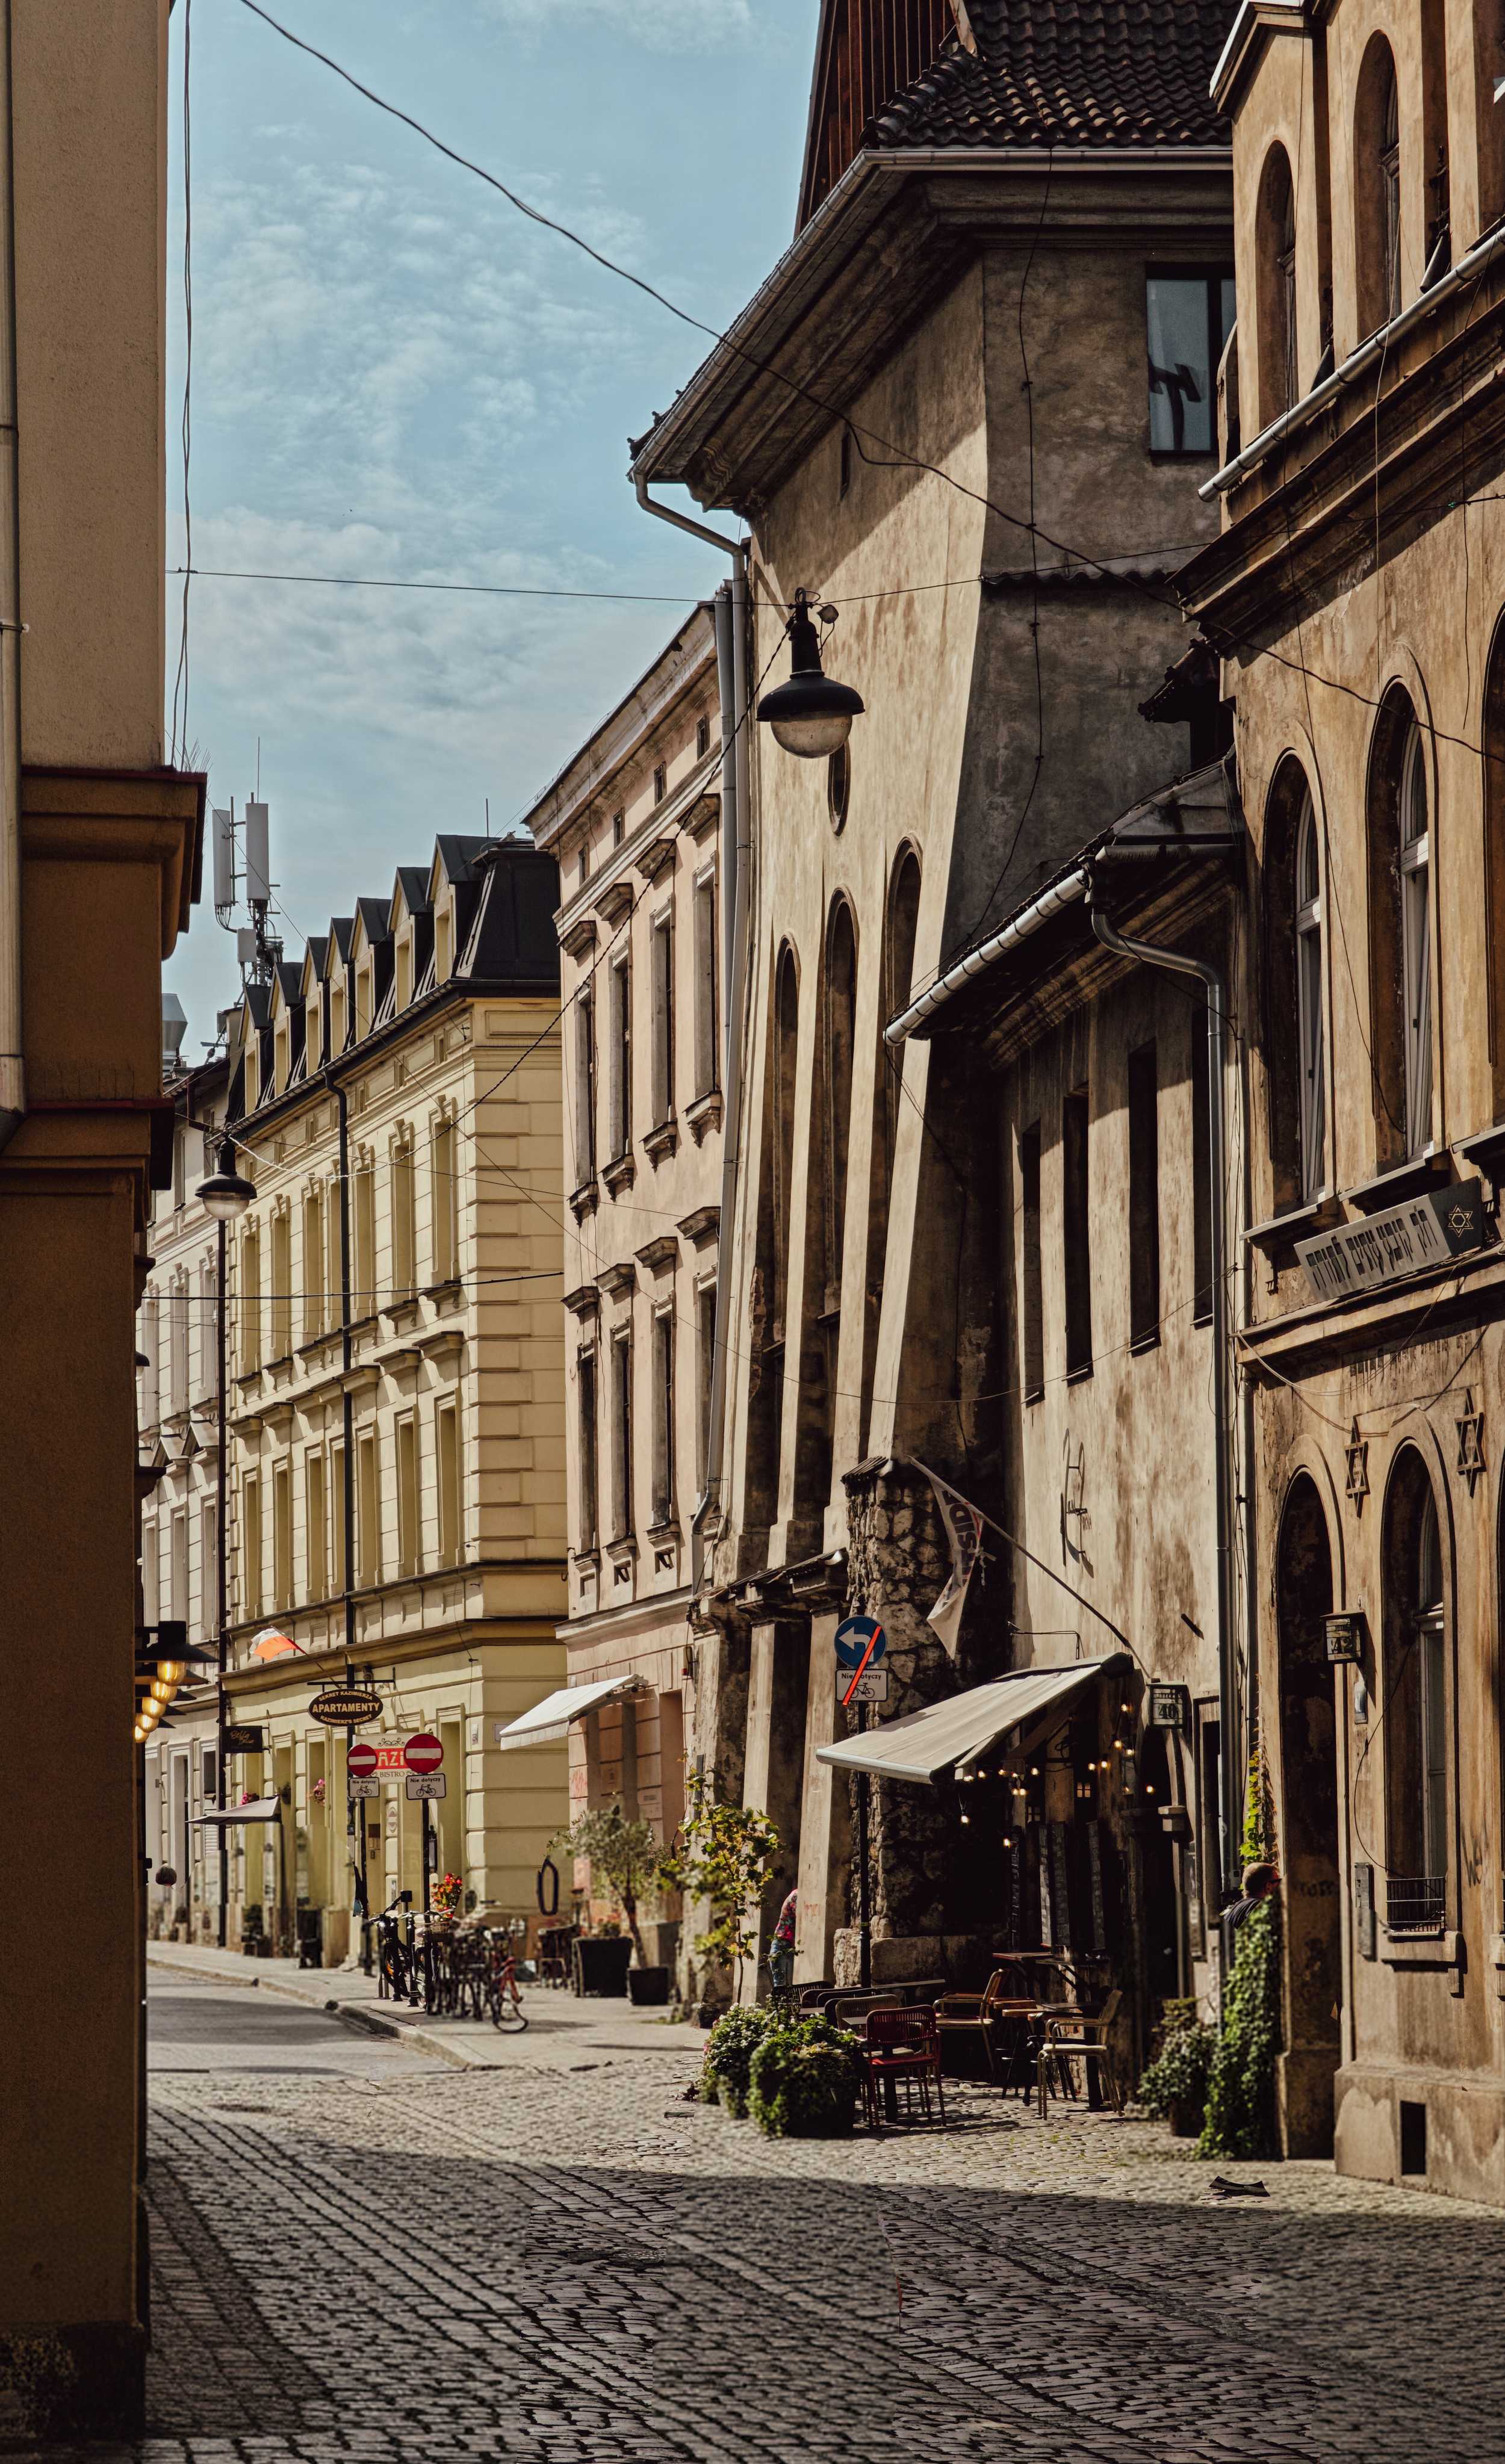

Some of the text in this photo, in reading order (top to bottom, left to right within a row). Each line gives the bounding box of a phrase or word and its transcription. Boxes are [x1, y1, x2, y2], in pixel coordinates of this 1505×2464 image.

[318, 1691, 373, 1701] SEKRET KAZIMIERZA
[312, 1702, 380, 1713] APARTAMENTY
[1158, 1703, 1177, 1719] 40
[320, 1713, 372, 1724] KAZIMIERZ'S SECRET
[229, 1730, 250, 1739] Bella
